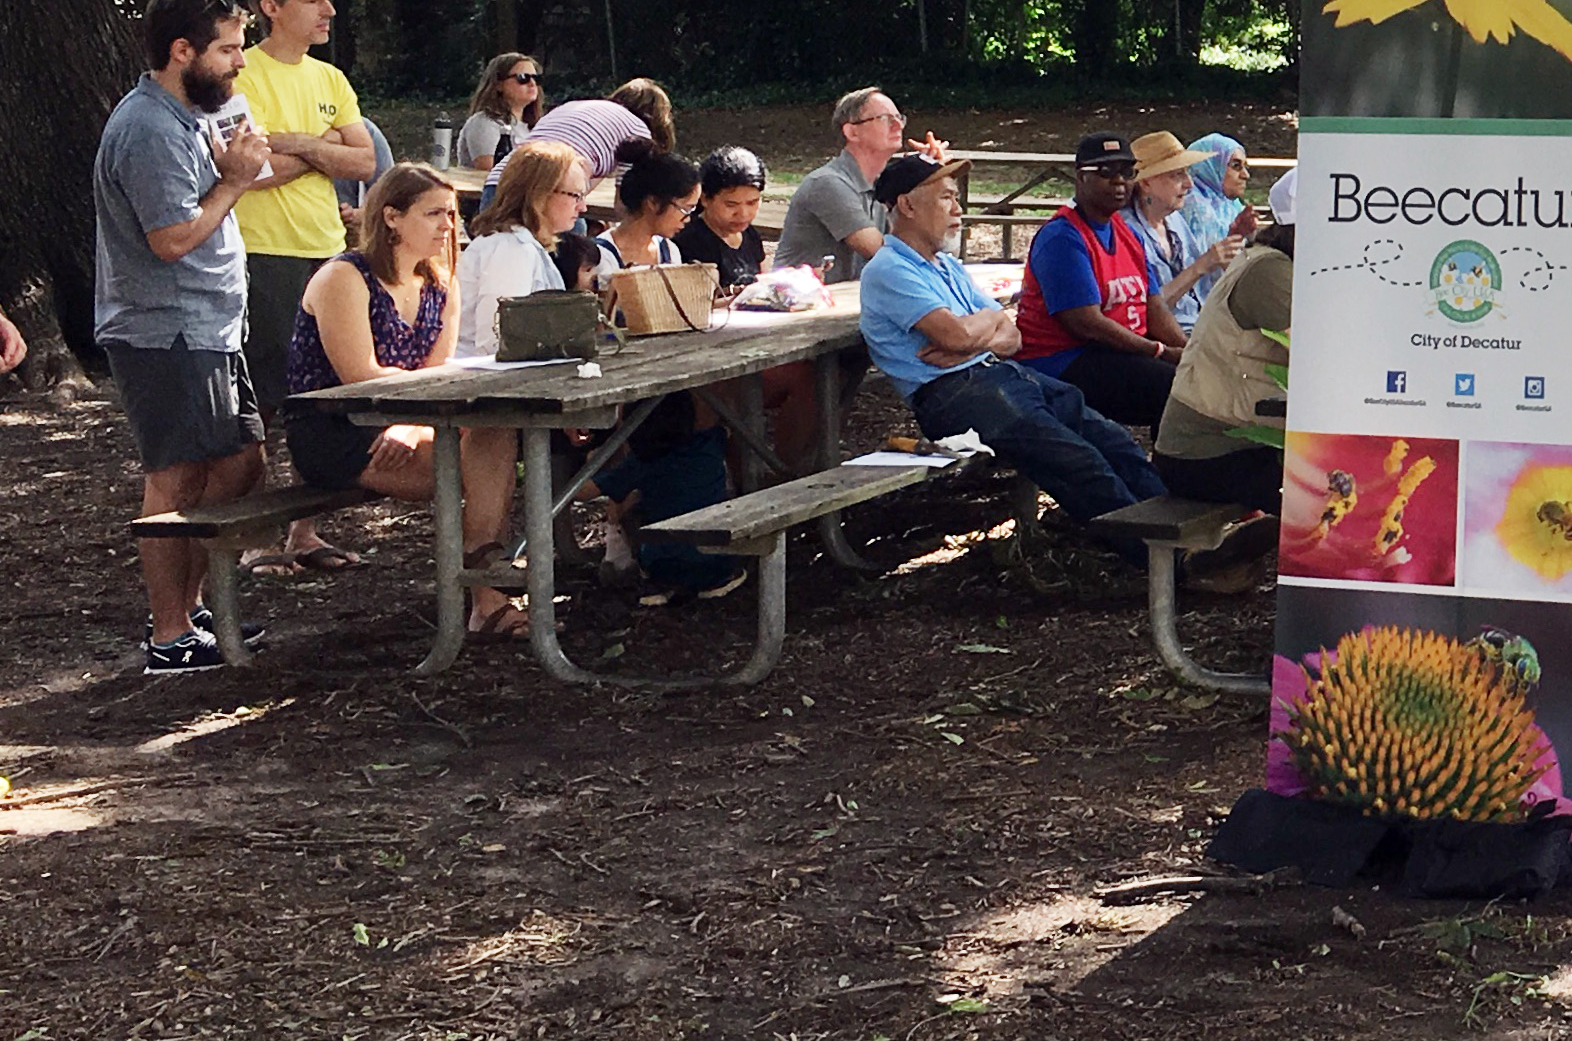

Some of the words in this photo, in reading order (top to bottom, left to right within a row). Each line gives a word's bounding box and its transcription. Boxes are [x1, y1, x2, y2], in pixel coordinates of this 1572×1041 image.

[1410, 333, 1441, 350] City
[1443, 334, 1458, 348] of
[1460, 335, 1522, 350] Decatur
